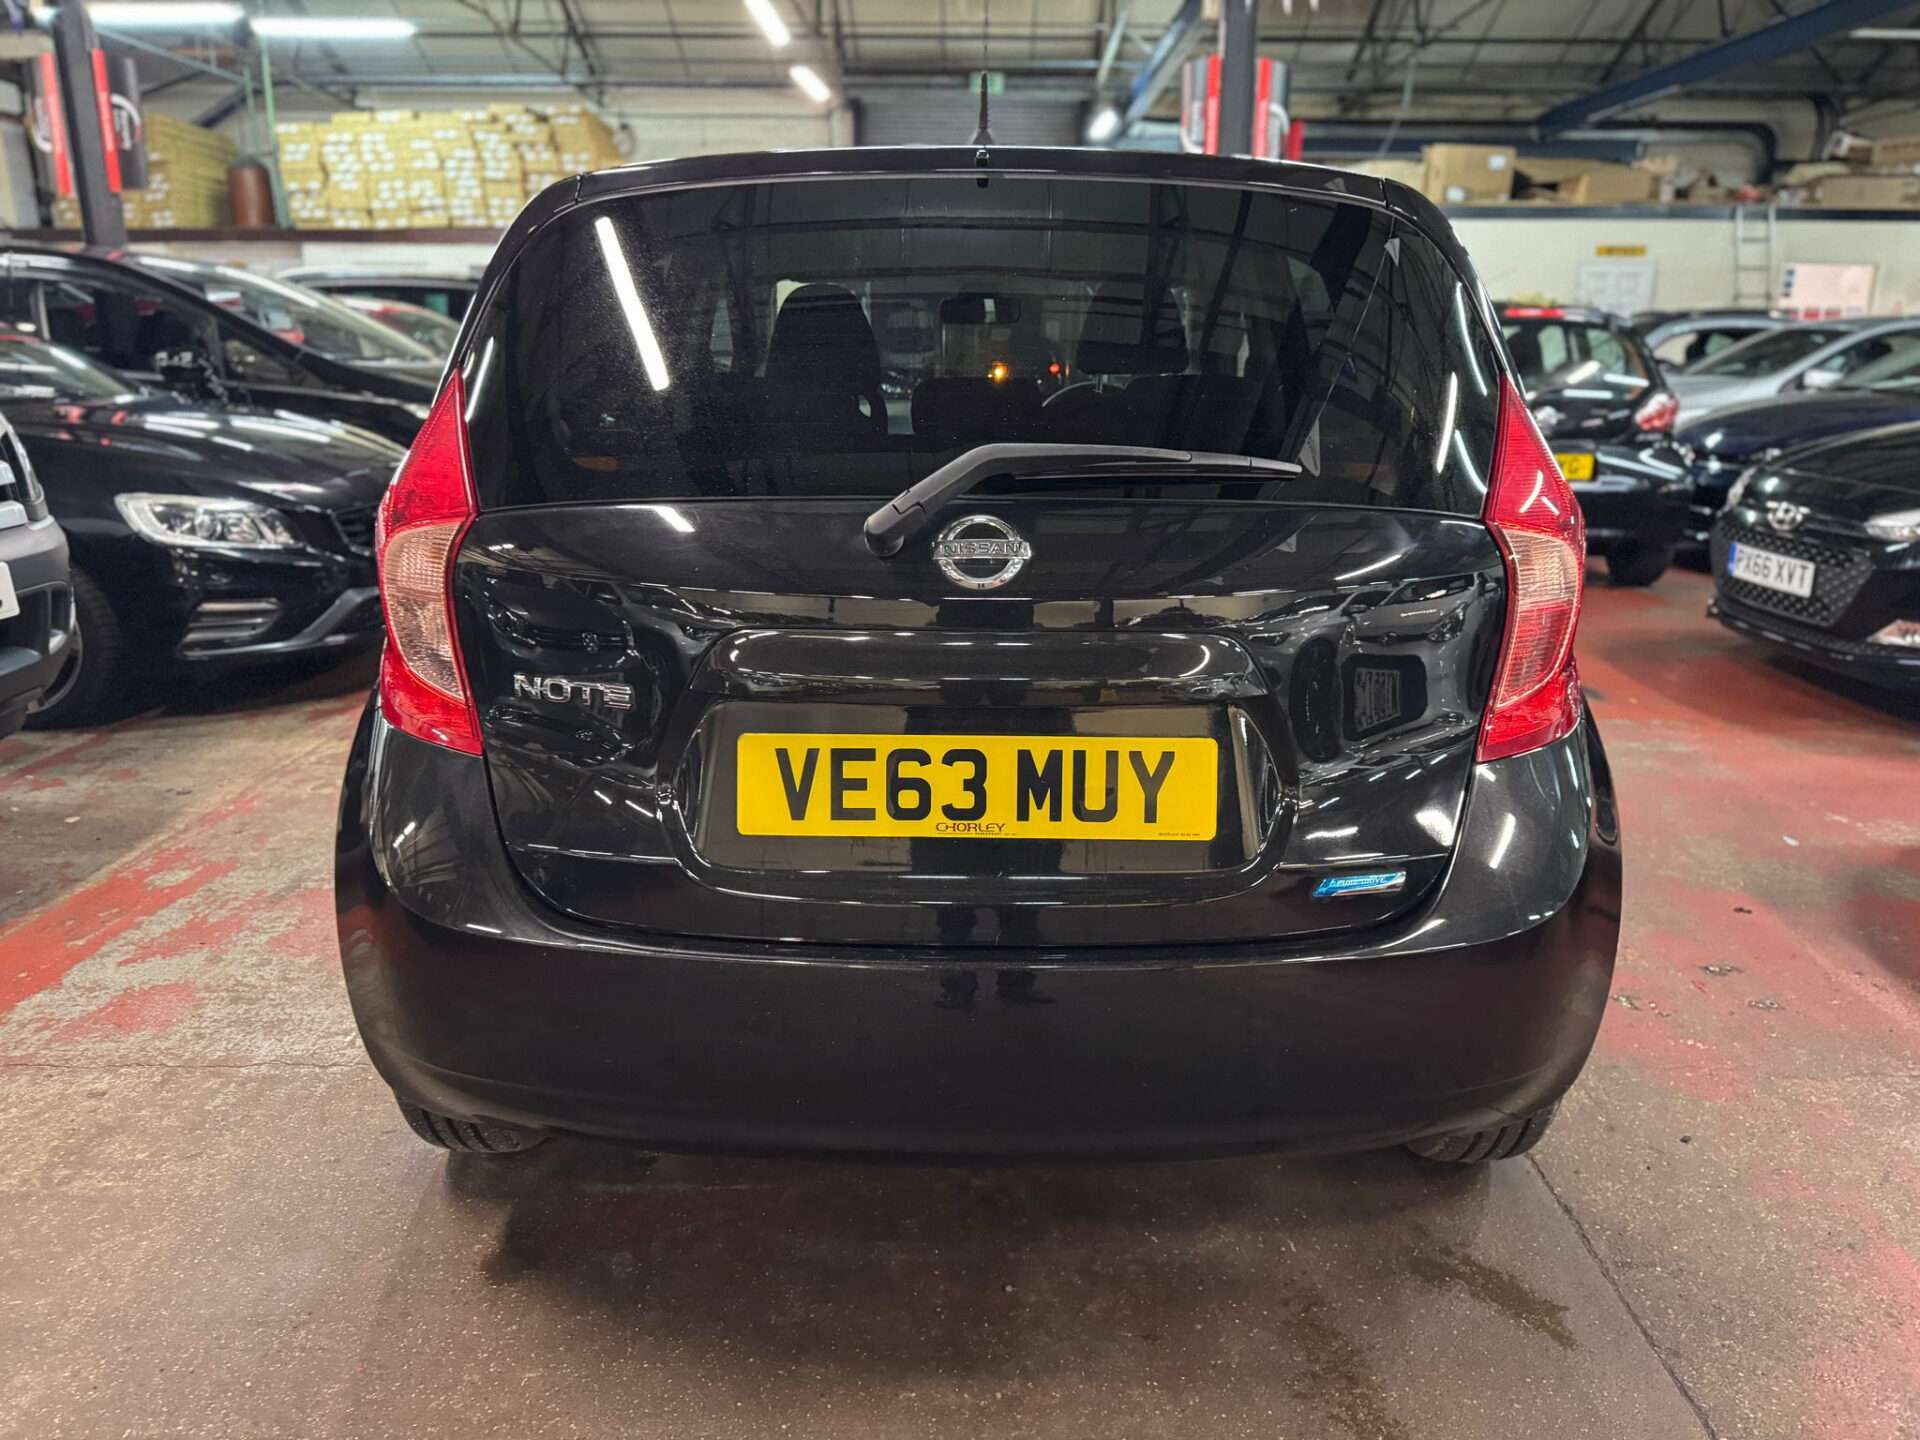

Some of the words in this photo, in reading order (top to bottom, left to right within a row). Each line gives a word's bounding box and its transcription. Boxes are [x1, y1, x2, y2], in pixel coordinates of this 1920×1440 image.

[943, 541, 1021, 557] NISSAN
[1774, 559, 1809, 588] XVT
[513, 673, 632, 709] NOTE
[775, 747, 988, 822] VE63
[1016, 749, 1175, 824] MUY
[935, 822, 1006, 833] CHORLEY
